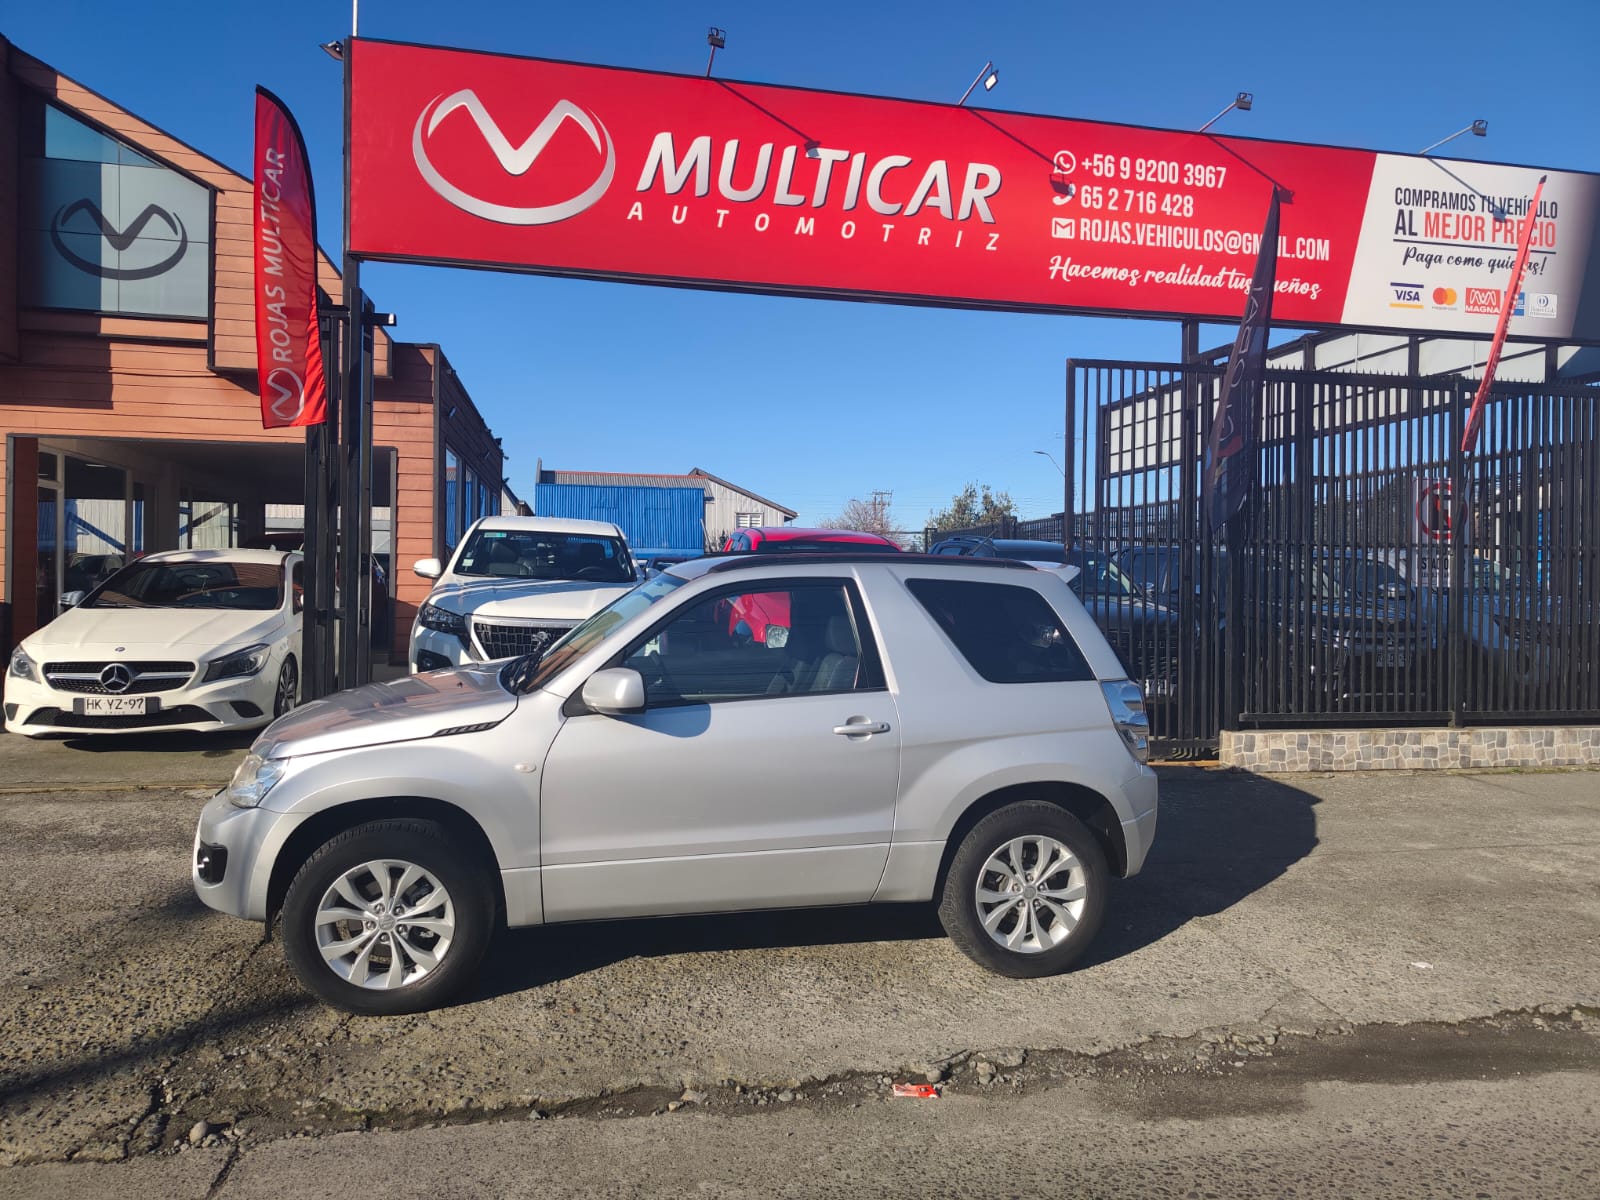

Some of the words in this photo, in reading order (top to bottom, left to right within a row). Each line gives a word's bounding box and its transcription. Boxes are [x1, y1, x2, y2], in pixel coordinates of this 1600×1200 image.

[635, 131, 1002, 224] MULTICAR
[1081, 153, 1115, 178] +56
[1119, 156, 1131, 180] 9
[1135, 158, 1179, 184] 9200
[1183, 163, 1227, 189] 3967
[261, 147, 286, 278] MULTICAR
[1080, 185, 1103, 209] 65
[1107, 188, 1119, 211] 2
[1124, 189, 1157, 214] 716
[1161, 193, 1194, 218] 428
[1394, 187, 1476, 212] COMPRAMOS
[1479, 194, 1494, 214] TU
[627, 201, 1000, 251] AUTOMOTRIZ
[1080, 218, 1330, 261] ROJAS.VEHICULOS@GMIL.COM
[1394, 209, 1418, 236] AL
[1423, 211, 1485, 242] MEJOR
[1048, 255, 1142, 287] Hacemos
[1143, 263, 1225, 289] realidad
[1220, 267, 1253, 295] tus
[1402, 246, 1444, 269] Paga
[1446, 254, 1485, 268] como
[1487, 255, 1547, 276] quieas!
[1395, 289, 1421, 302] VISA
[1465, 304, 1501, 314] MAGNA
[265, 285, 293, 363] ROJAS
[86, 698, 103, 710] HK
